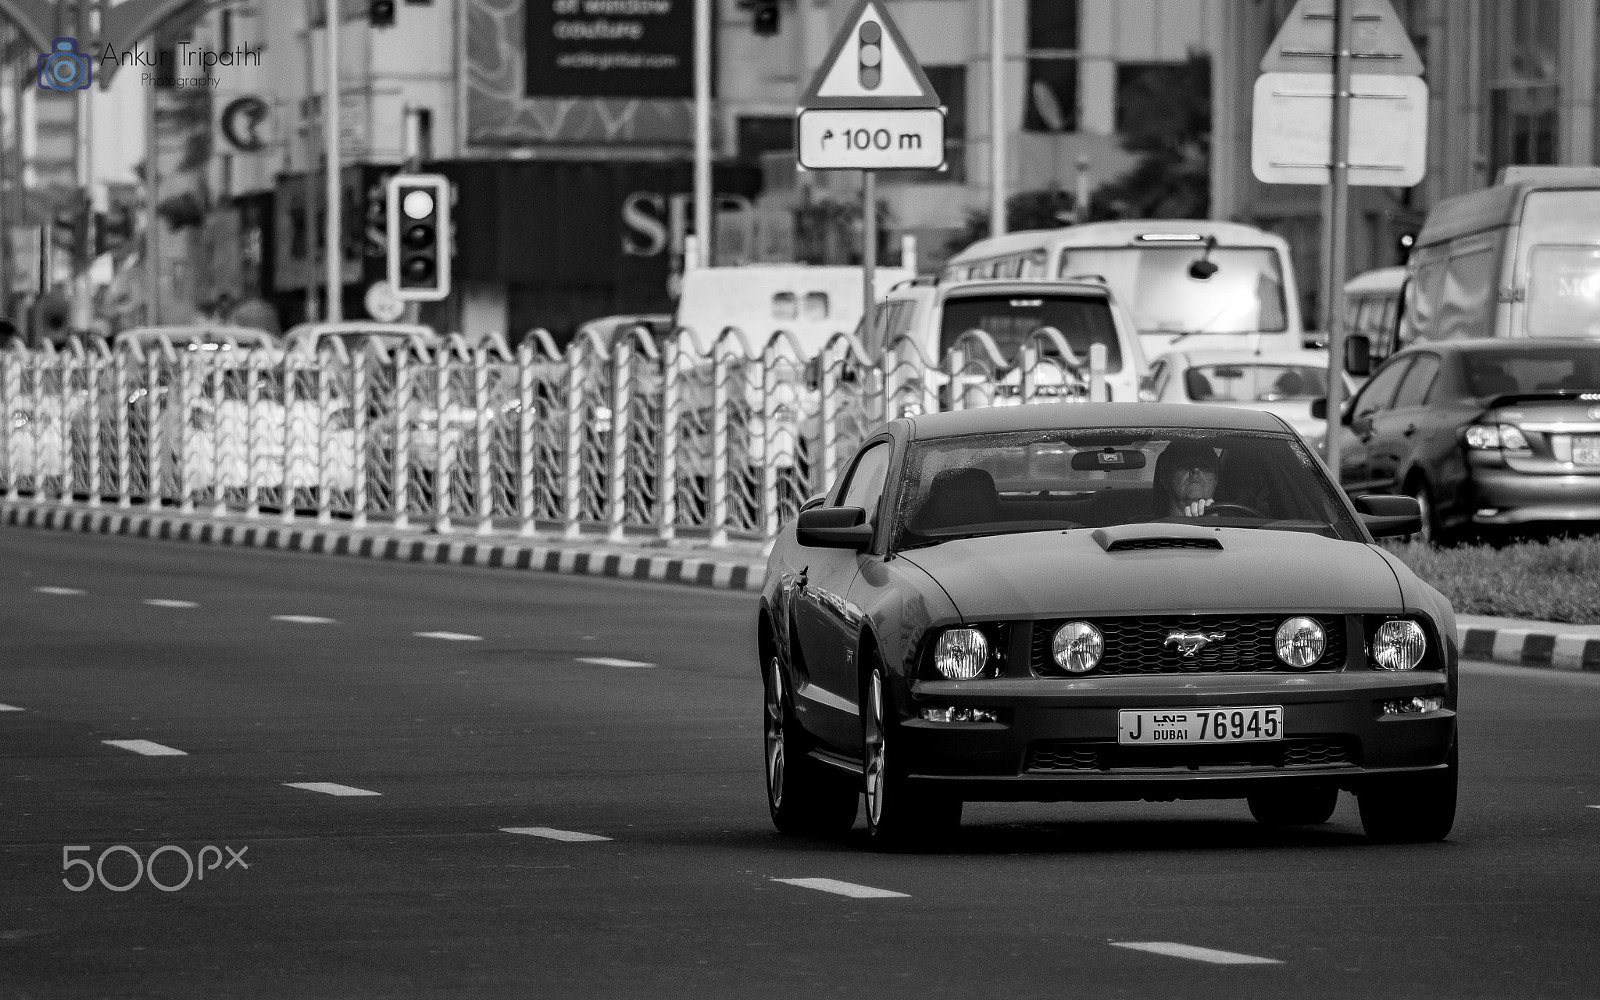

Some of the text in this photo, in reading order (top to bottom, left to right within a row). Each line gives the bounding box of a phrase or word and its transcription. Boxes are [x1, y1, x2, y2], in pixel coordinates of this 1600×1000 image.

[841, 128, 891, 150] 100
[899, 133, 922, 149] m
[1129, 710, 1278, 740] J 76945
[1153, 715, 1187, 727] دبي
[1153, 729, 1188, 741] DUBAI
